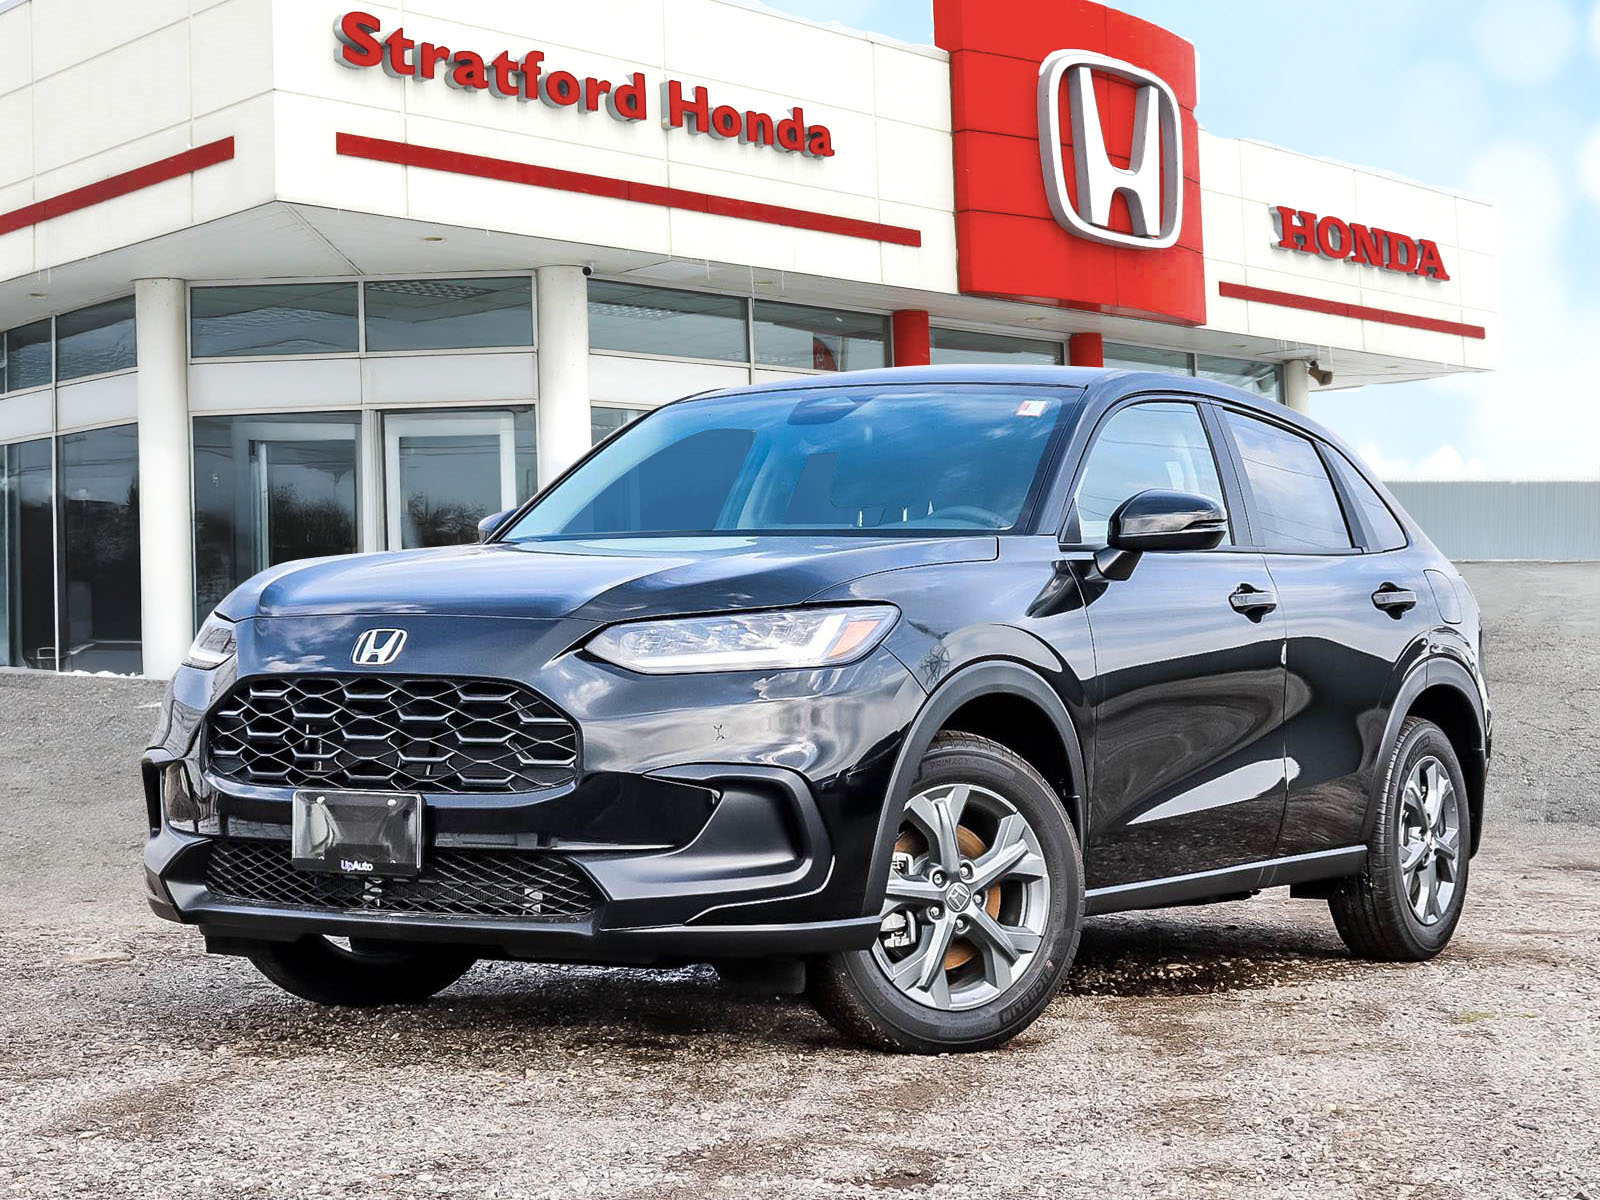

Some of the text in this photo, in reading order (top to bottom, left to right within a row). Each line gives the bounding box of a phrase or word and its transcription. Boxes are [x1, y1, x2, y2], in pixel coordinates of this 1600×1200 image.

[335, 10, 835, 159] Stratford Honda
[1270, 204, 1451, 283] HONDA
[340, 859, 374, 872] UpAuto
